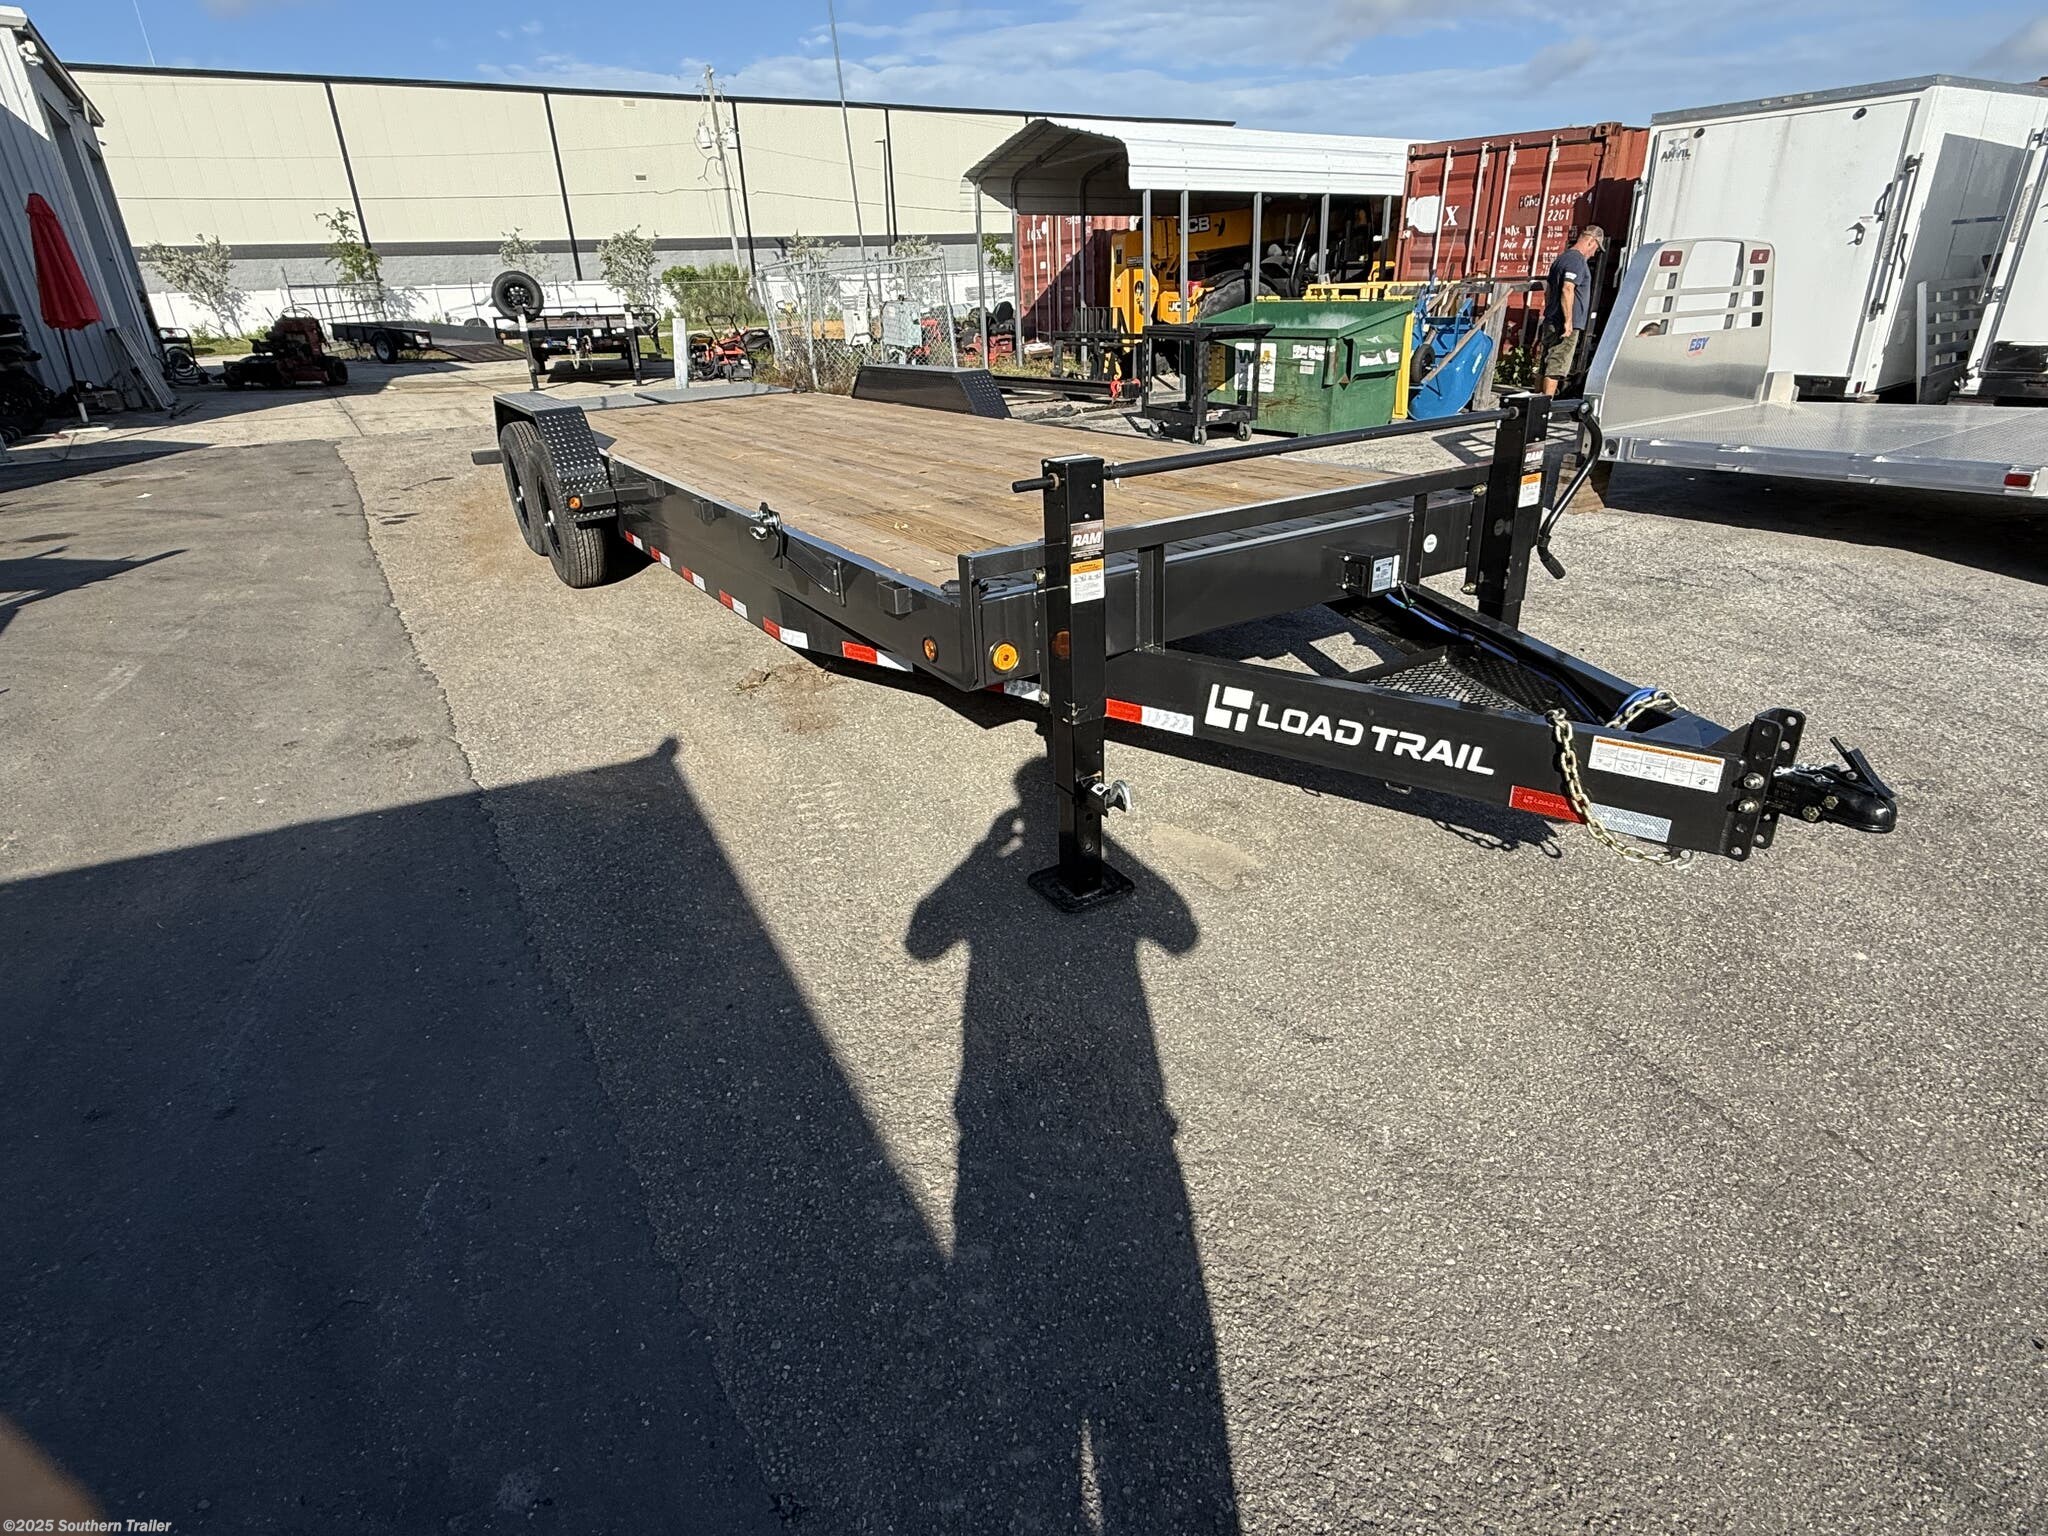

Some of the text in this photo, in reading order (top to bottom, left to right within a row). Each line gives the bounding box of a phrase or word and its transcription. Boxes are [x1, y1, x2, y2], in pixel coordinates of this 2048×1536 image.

[1661, 149, 1691, 160] ANVIL
[1688, 336, 1710, 351] EBY
[1072, 531, 1102, 548] RAM
[1257, 704, 1364, 746] LOAD
[1370, 725, 1495, 775] TRAIL
